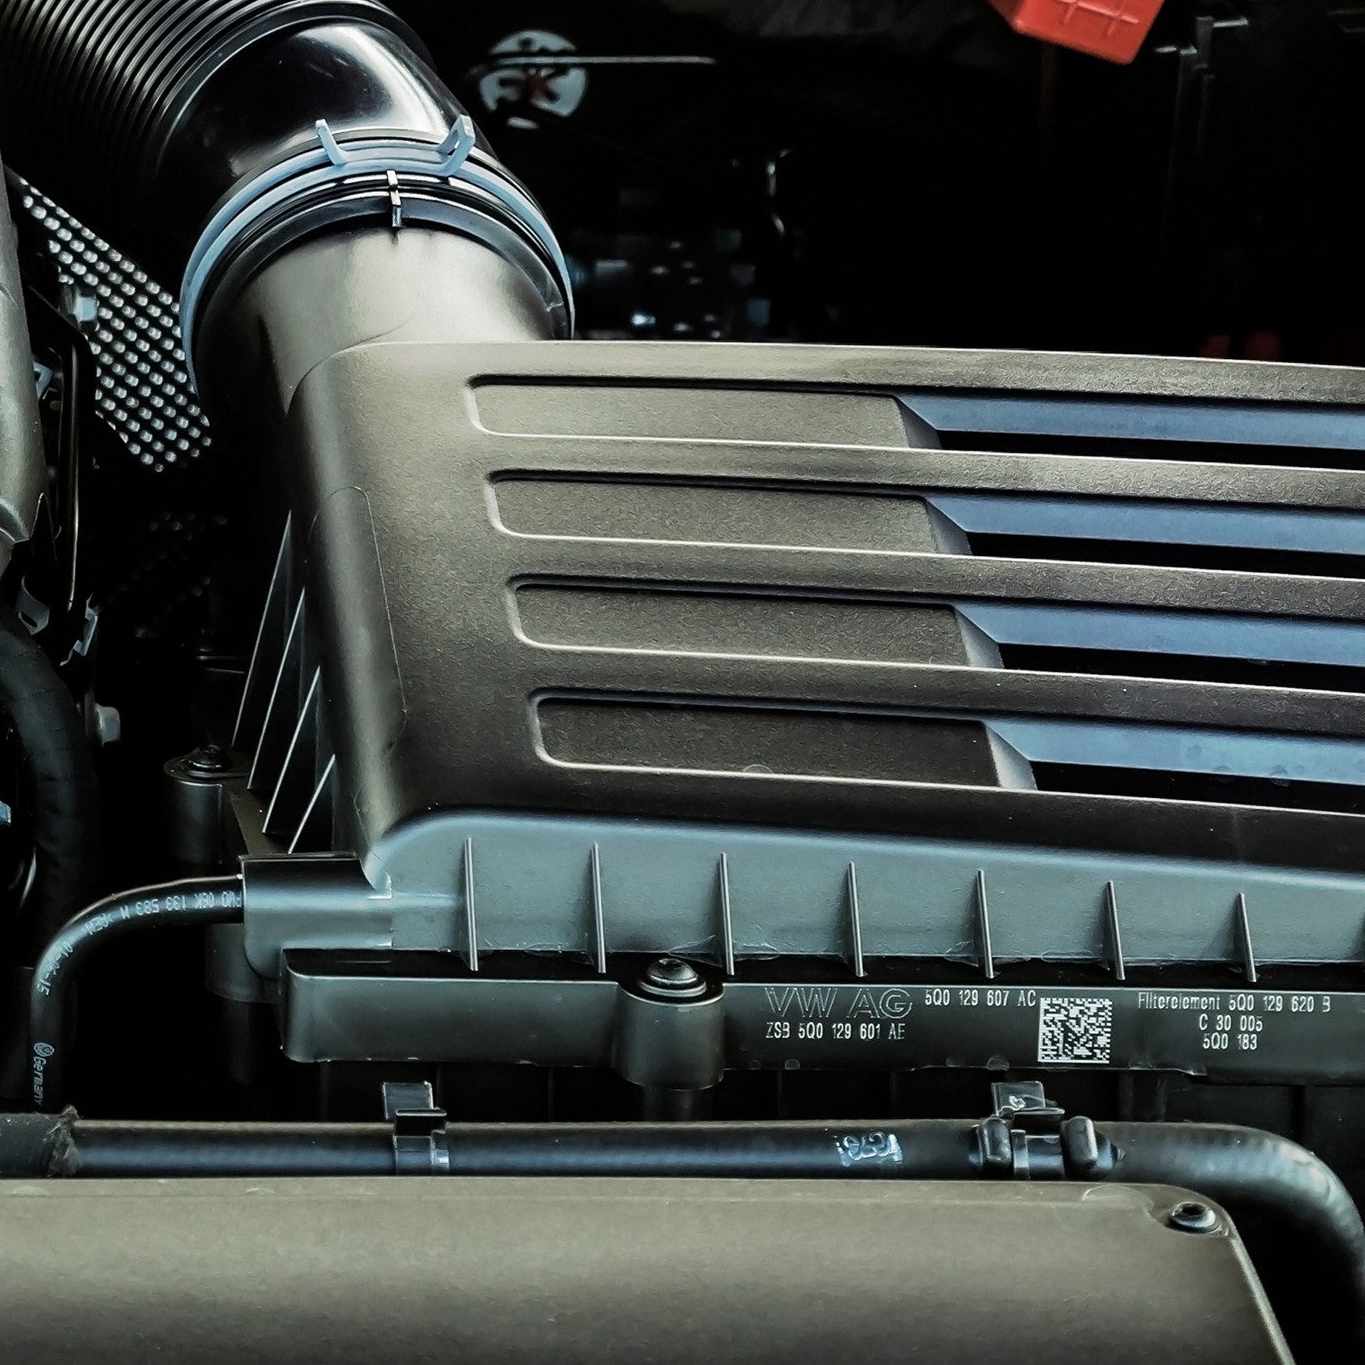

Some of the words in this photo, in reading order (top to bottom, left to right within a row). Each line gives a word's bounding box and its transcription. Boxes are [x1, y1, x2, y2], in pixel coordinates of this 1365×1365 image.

[135, 898, 160, 916] 583
[165, 895, 187, 911] 133
[764, 987, 838, 1018] VW
[846, 988, 913, 1019] AG
[925, 989, 951, 1006] 5Q0
[959, 989, 979, 1006] 129
[986, 990, 1010, 1007] 607
[1017, 990, 1036, 1007] AC
[1228, 994, 1255, 1012] 5Q0
[1262, 995, 1283, 1012] 129
[1291, 995, 1314, 1013] 620
[765, 1021, 790, 1039] ZSB
[798, 1022, 824, 1040] 5Q0
[832, 1023, 852, 1040] 129
[860, 1023, 880, 1040] 601
[888, 1023, 905, 1040] AE
[1199, 1014, 1208, 1031] C
[1216, 1014, 1231, 1031] 30
[1240, 1015, 1263, 1032] 005
[1203, 1032, 1228, 1050] 5Q0
[1237, 1034, 1258, 1050] 183
[33, 1055, 47, 1107] Germany
